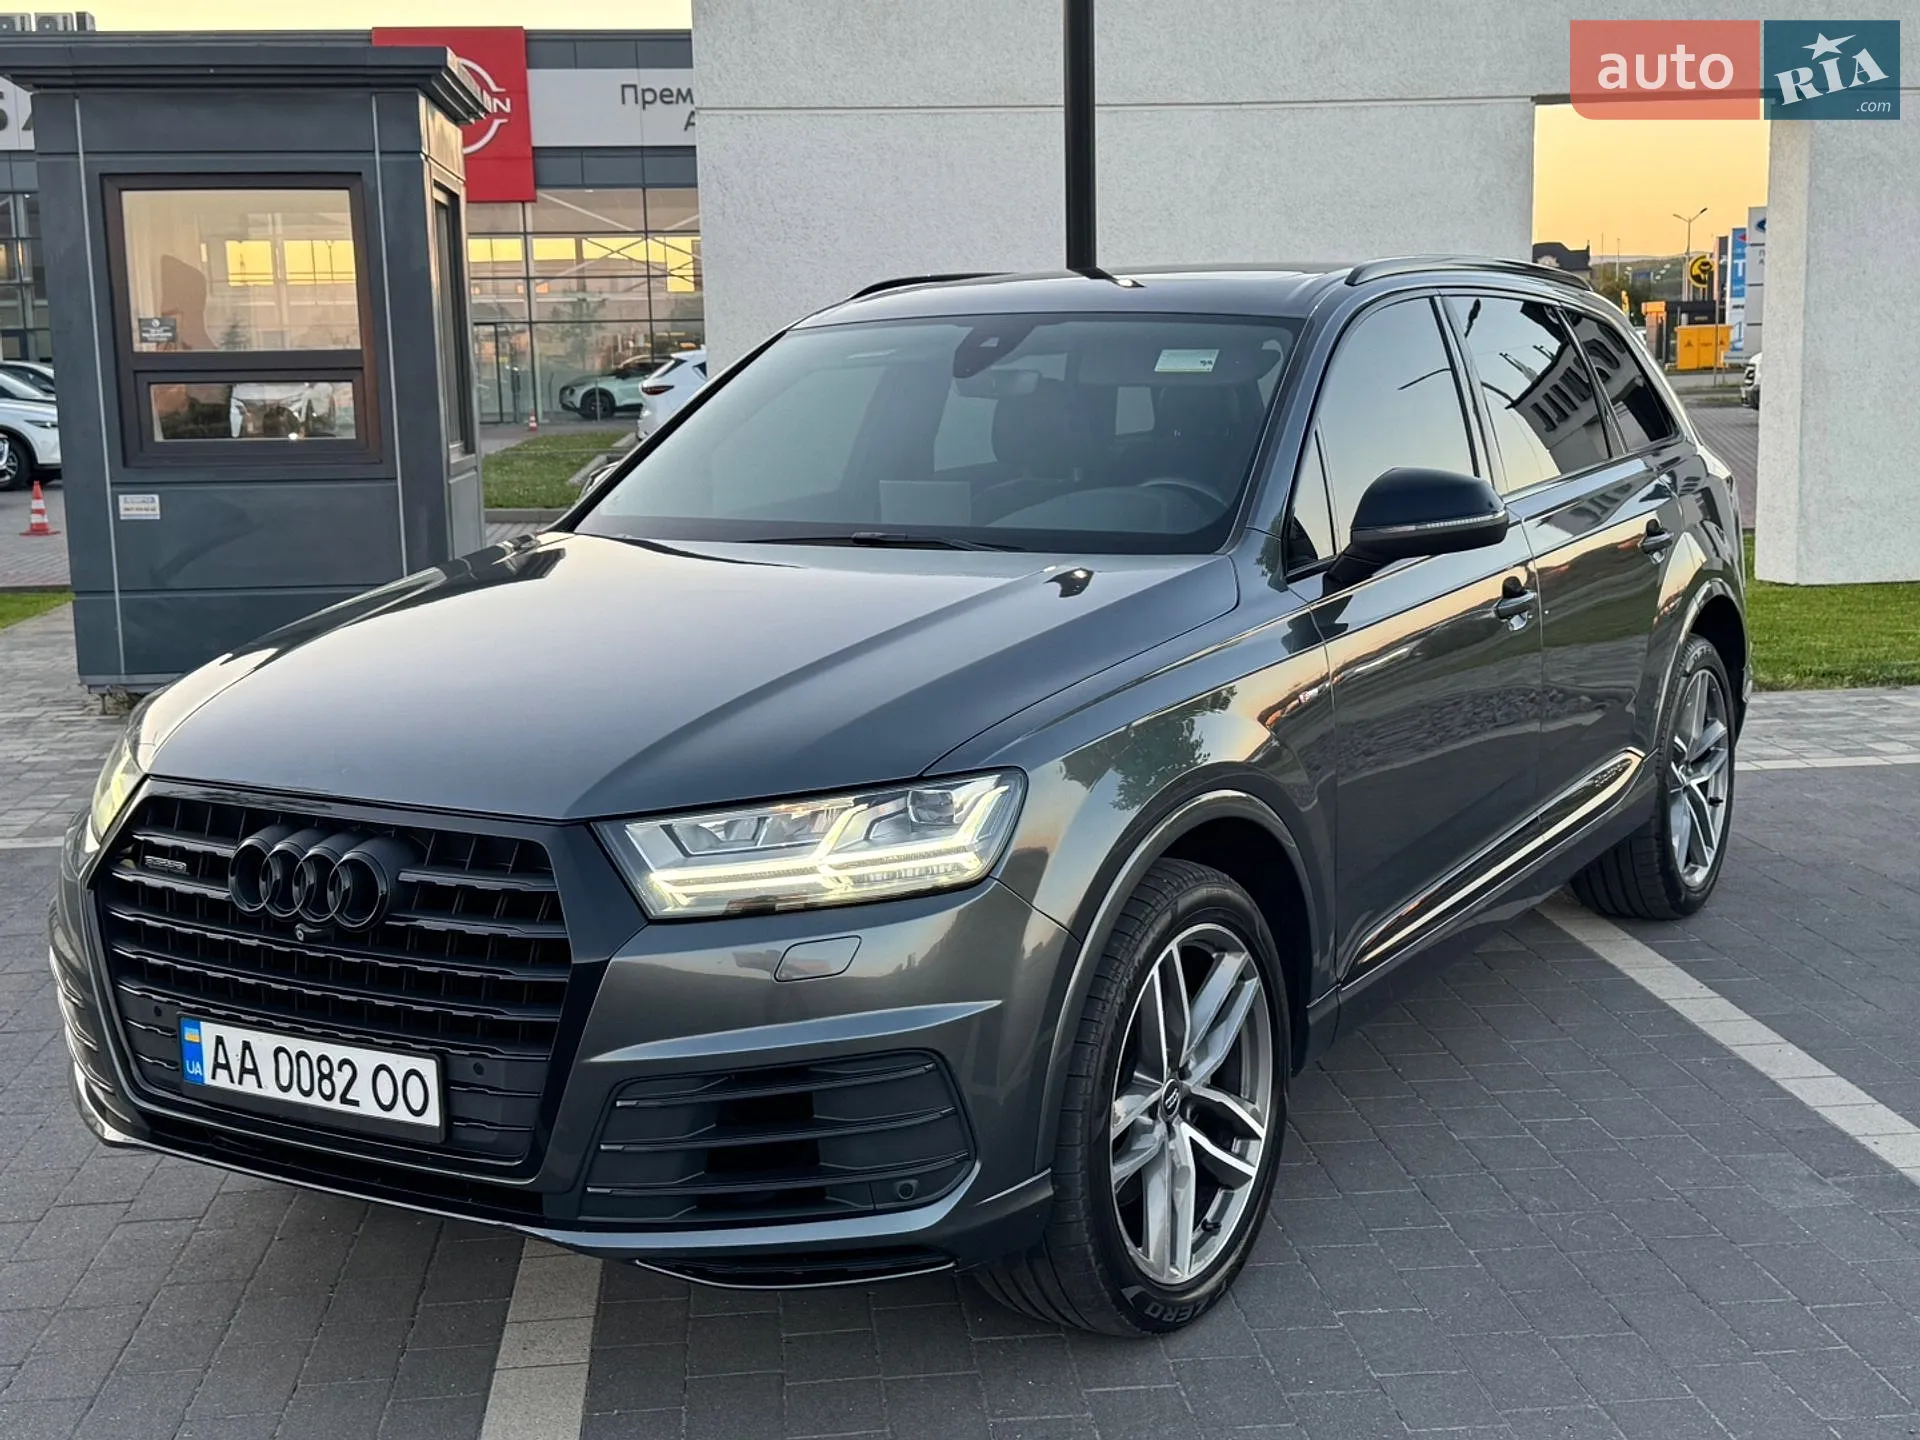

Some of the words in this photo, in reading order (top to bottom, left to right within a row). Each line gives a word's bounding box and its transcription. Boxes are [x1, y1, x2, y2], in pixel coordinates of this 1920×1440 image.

[620, 84, 694, 111] Прем
[186, 1059, 203, 1076] UA
[211, 1034, 263, 1089] AA
[273, 1045, 361, 1108] 0082
[371, 1062, 430, 1118] OO
